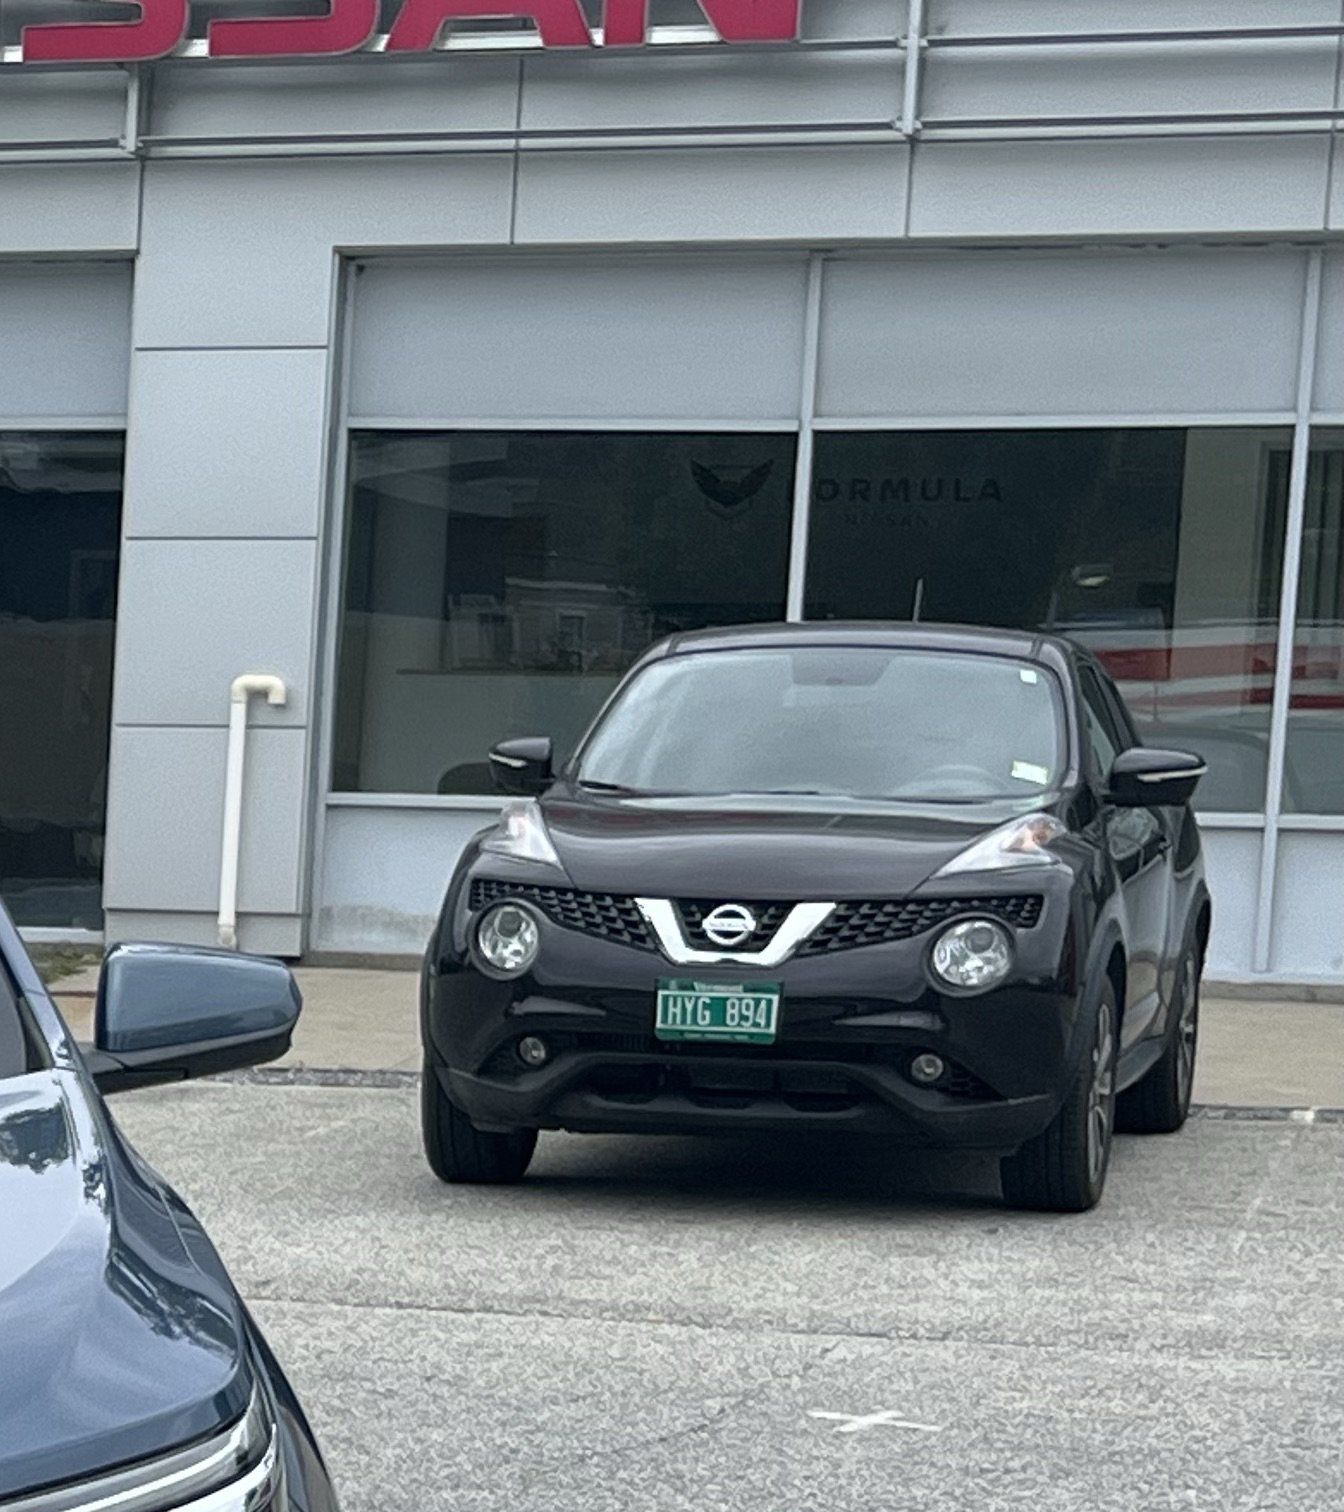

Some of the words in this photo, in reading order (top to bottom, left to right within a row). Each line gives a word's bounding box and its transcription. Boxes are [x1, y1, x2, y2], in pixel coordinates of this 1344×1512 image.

[788, 475, 1003, 502] ORMULA
[667, 996, 711, 1026] HYG
[725, 998, 768, 1029] 894
